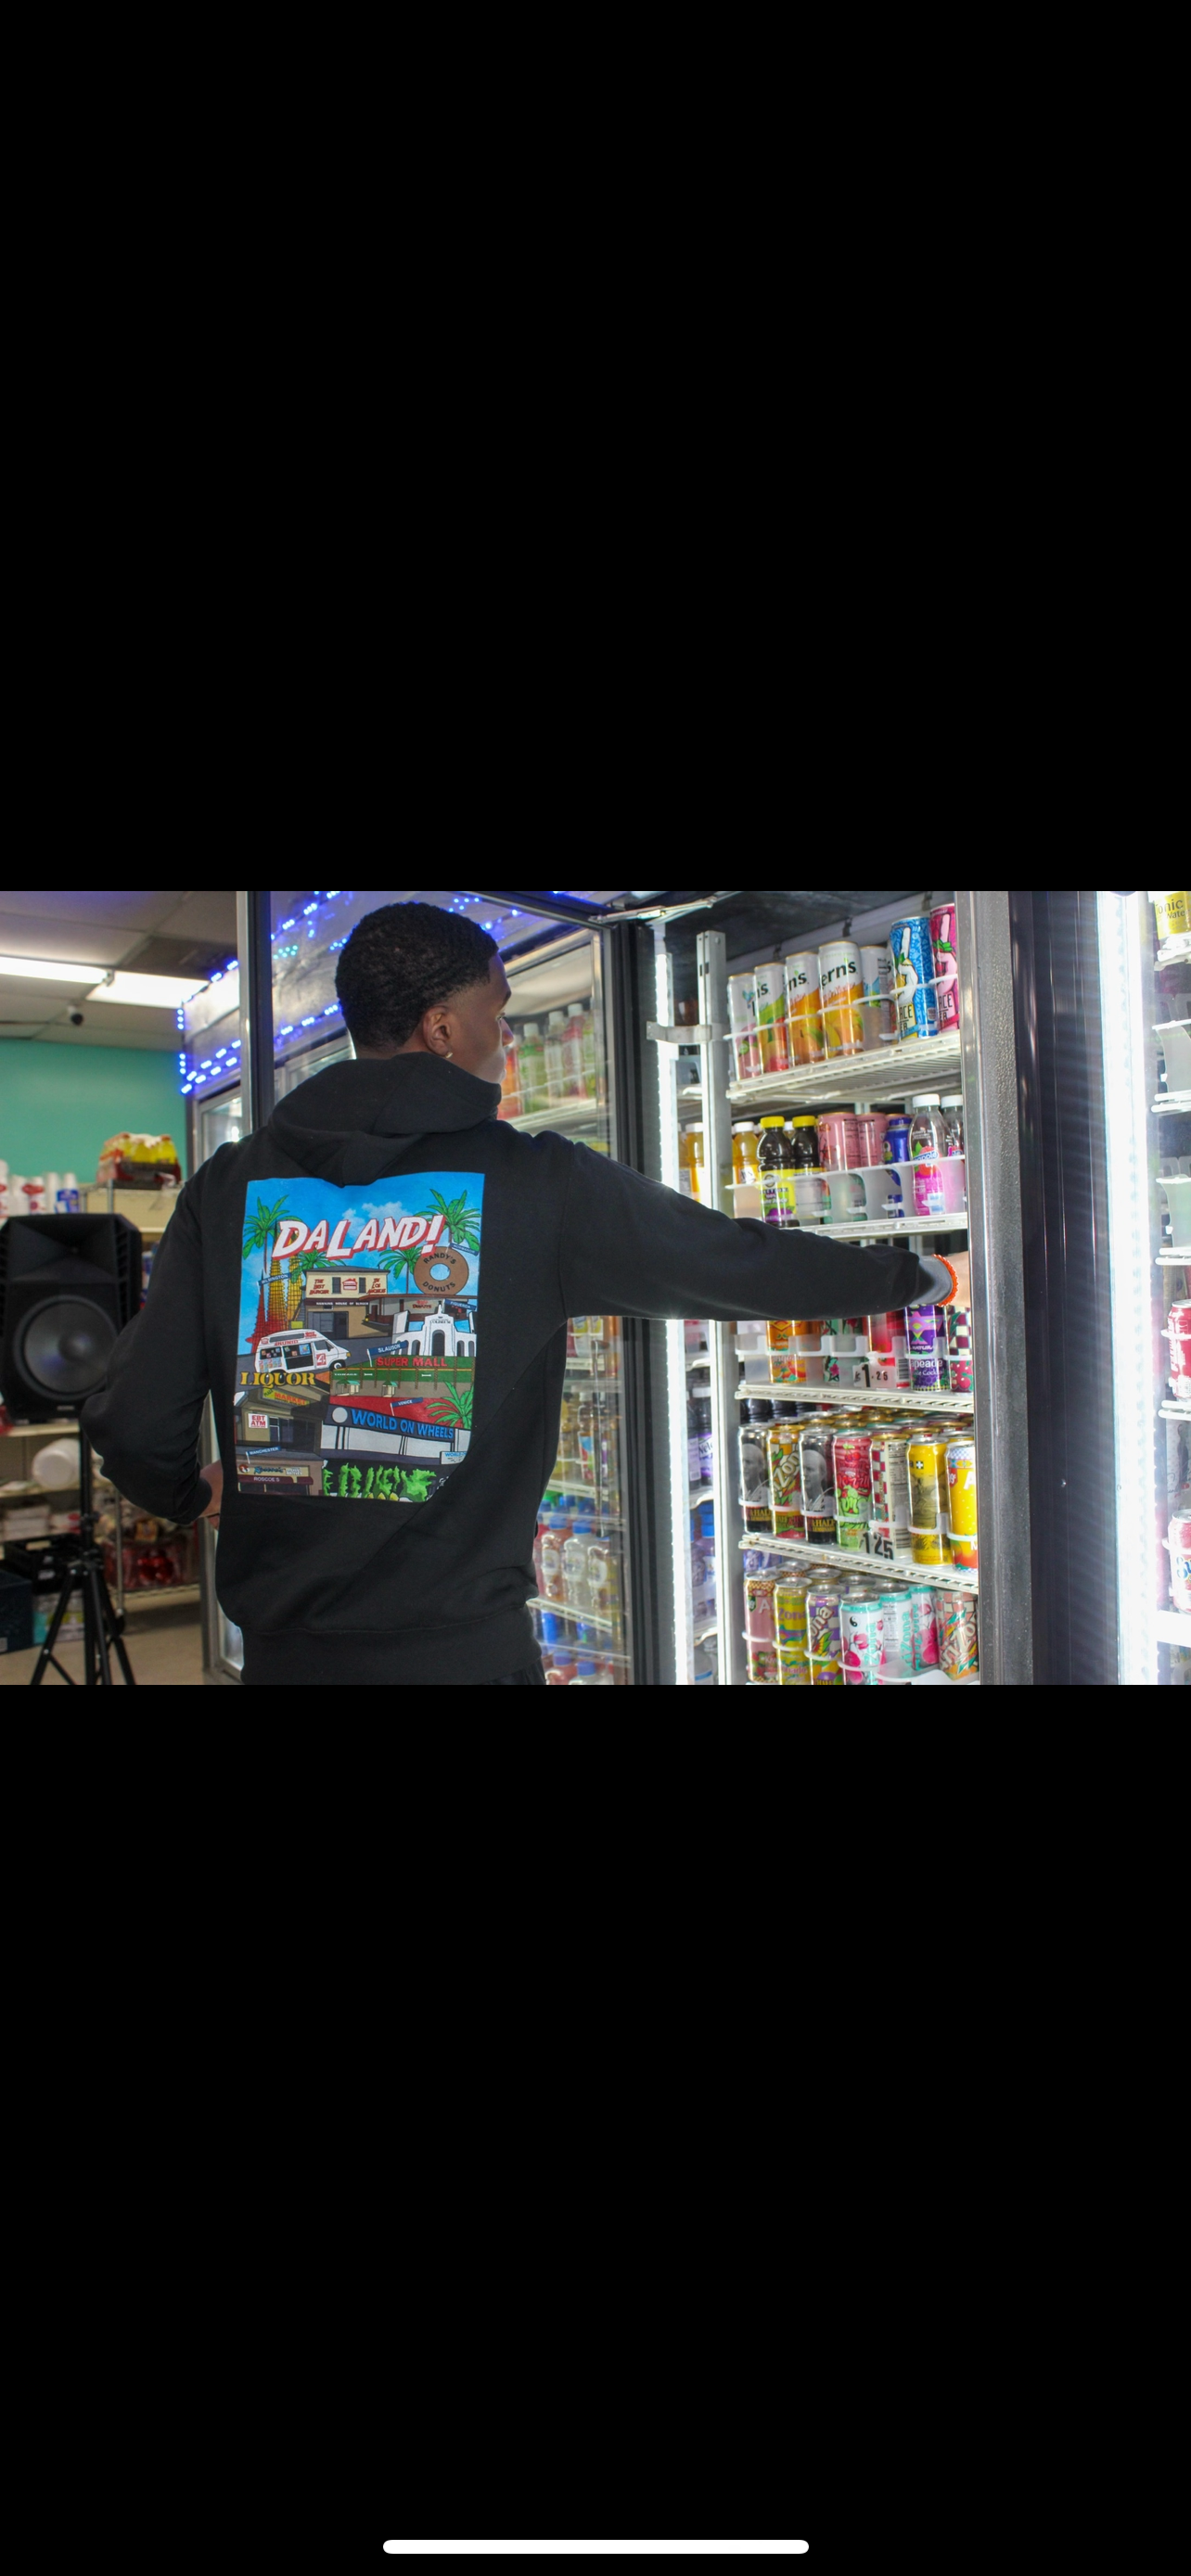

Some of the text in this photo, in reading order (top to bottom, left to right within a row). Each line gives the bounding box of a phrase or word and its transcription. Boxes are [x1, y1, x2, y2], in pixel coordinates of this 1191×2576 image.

[423, 1252, 457, 1265] RANDY'S
[422, 1281, 456, 1293] DONUTS
[378, 1343, 401, 1353] SLAUSON
[317, 1354, 326, 1364] 4
[377, 1357, 447, 1367] SUPER MALL
[239, 1372, 316, 1389] LIQUOR
[351, 1409, 454, 1439] WORLD ON WHEELS
